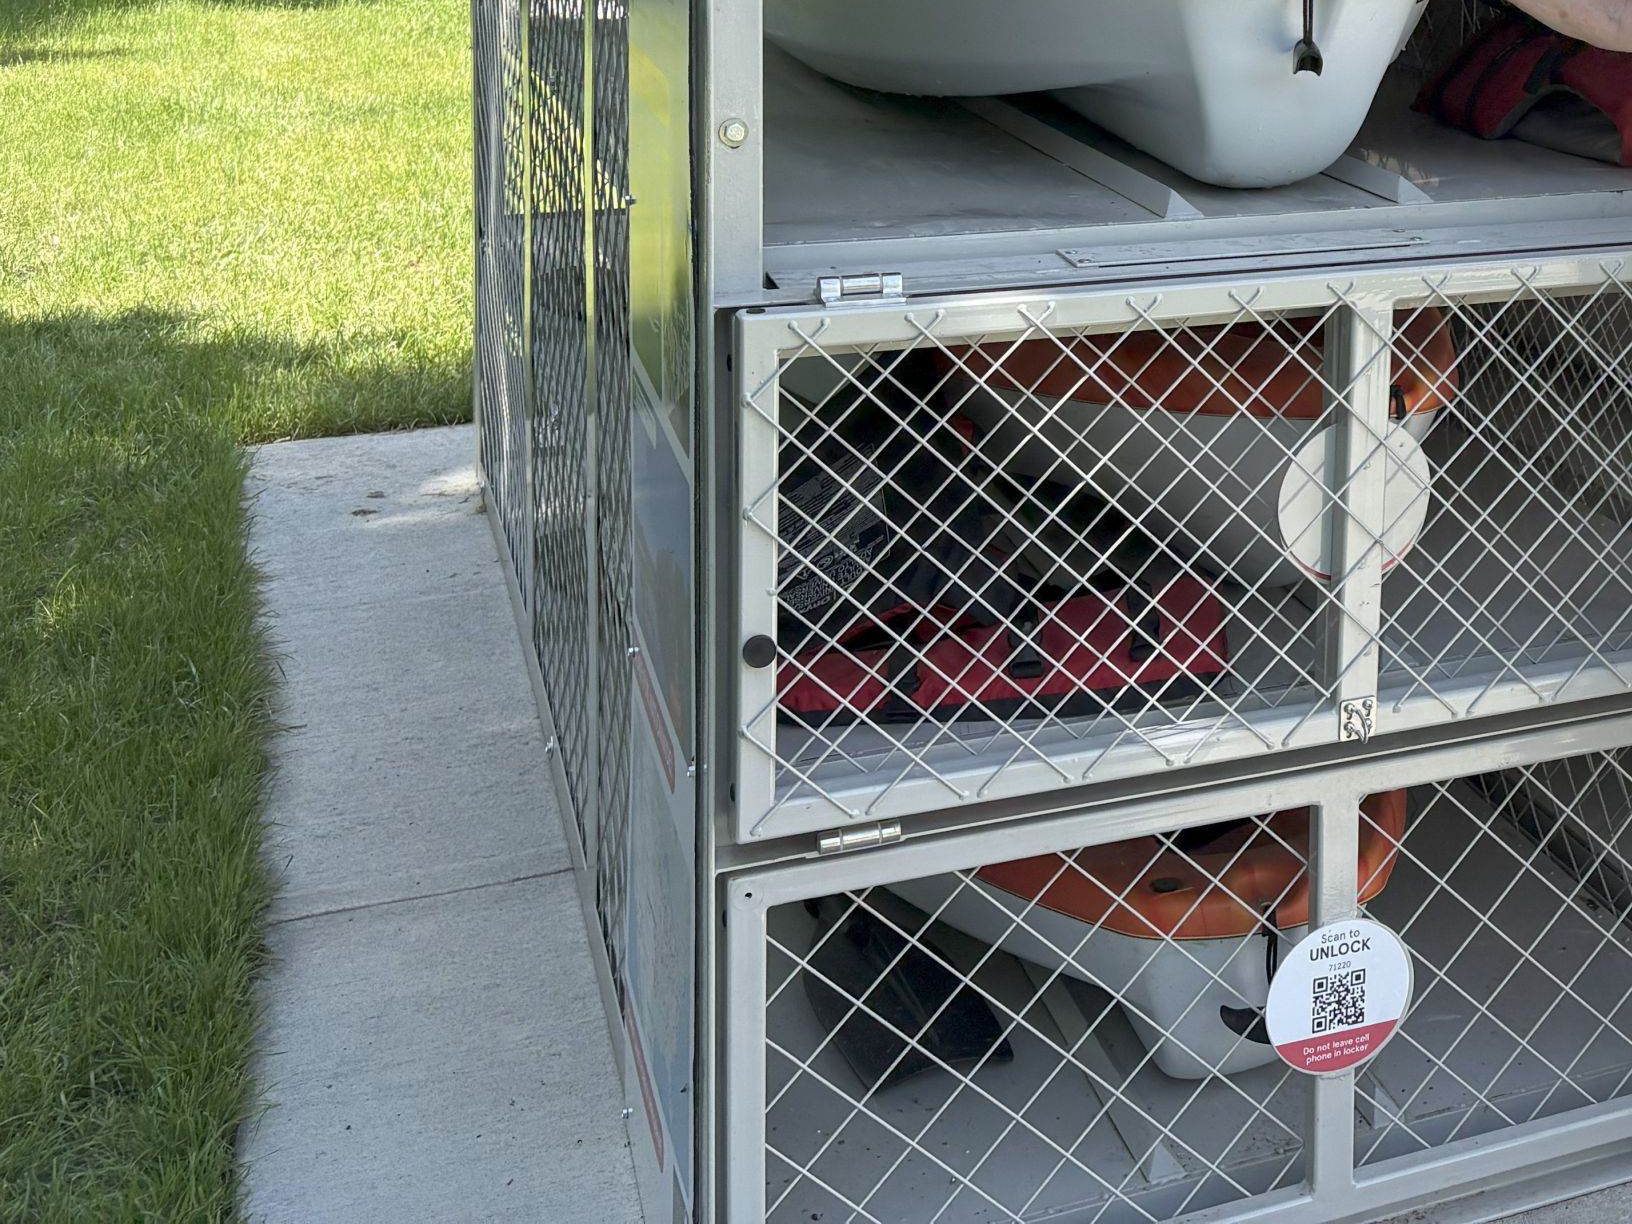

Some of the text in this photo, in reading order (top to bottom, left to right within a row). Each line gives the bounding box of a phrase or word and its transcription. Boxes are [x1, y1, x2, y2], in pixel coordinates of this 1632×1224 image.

[1321, 929, 1360, 944] Scan to
[1310, 938, 1371, 961] UNLOCK
[1328, 961, 1351, 972] 71220
[1303, 1033, 1370, 1056] Do not leave cell
[1306, 1053, 1332, 1065] phone
[1343, 1044, 1368, 1055] locker
